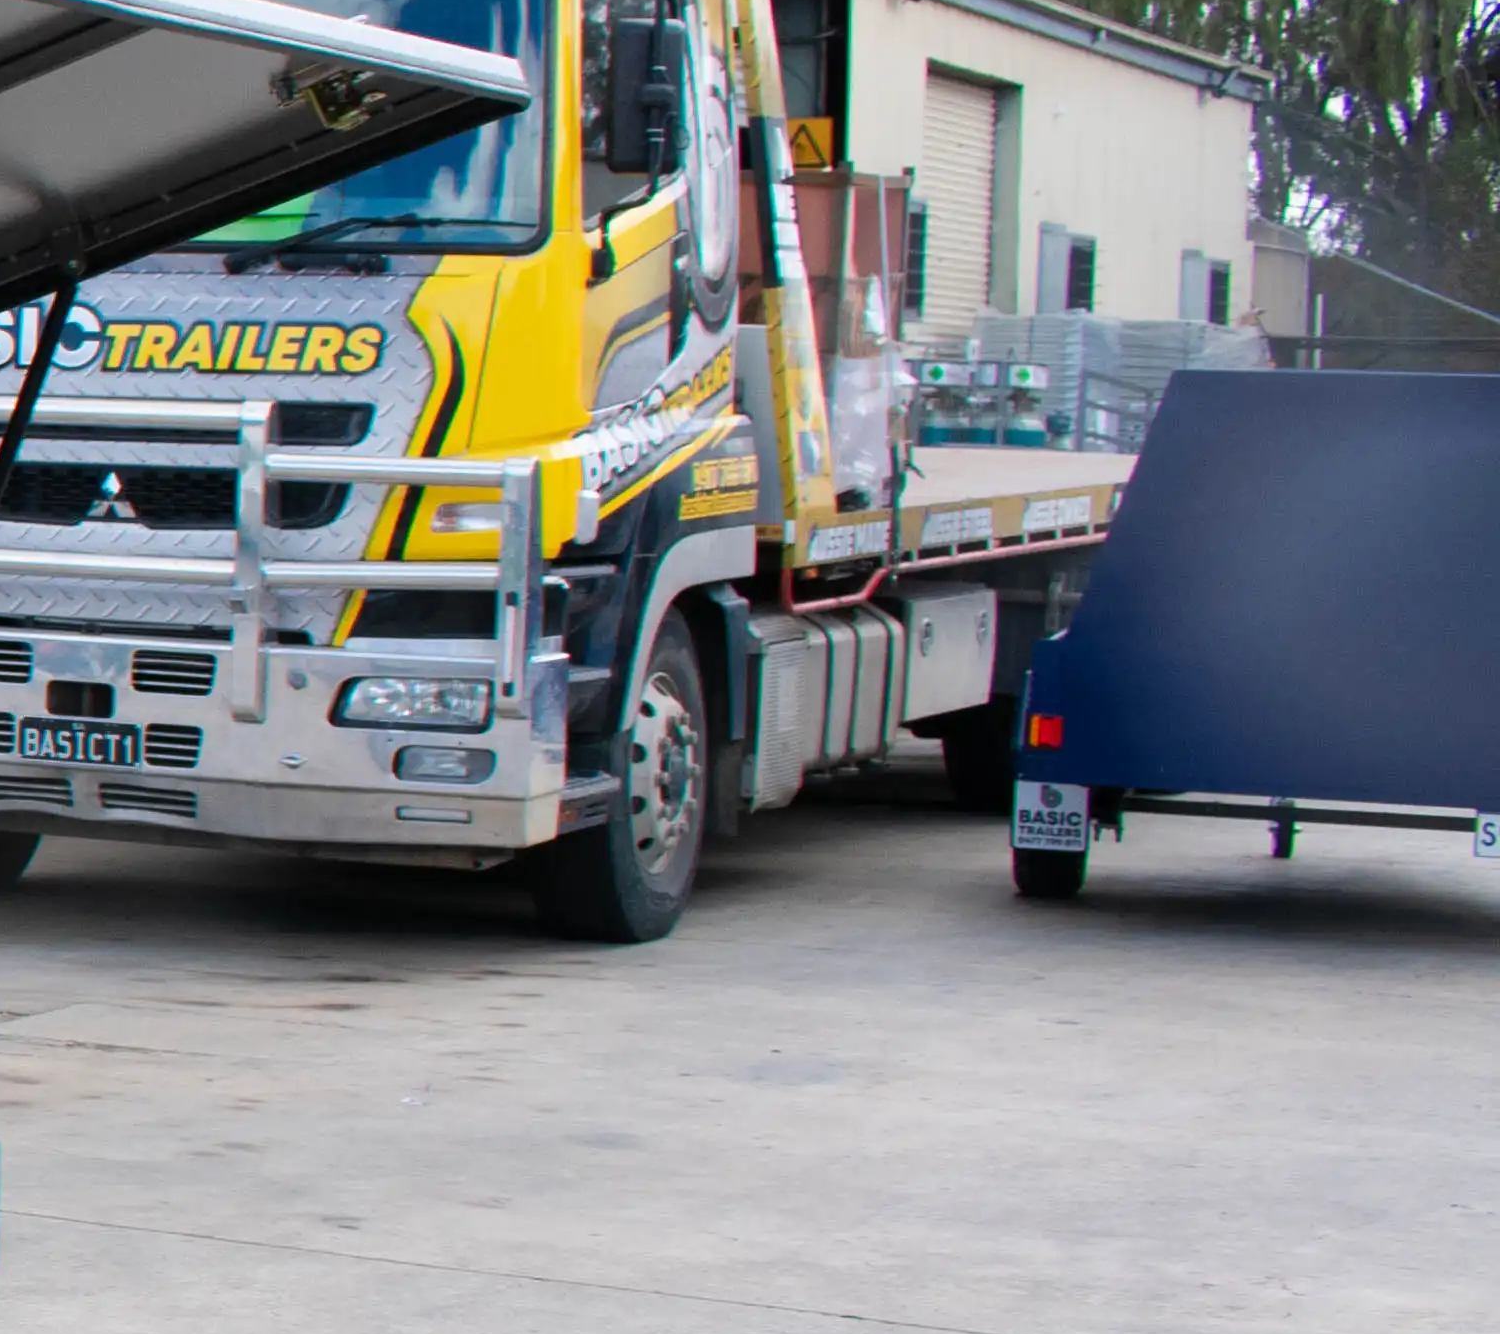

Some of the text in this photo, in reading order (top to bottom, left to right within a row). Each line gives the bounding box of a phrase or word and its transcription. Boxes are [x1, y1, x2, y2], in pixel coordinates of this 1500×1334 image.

[103, 321, 384, 373] TRAILERS
[23, 726, 135, 764] BASICT1
[1018, 809, 1082, 826] BASIC
[1018, 825, 1082, 838] TRAILERS
